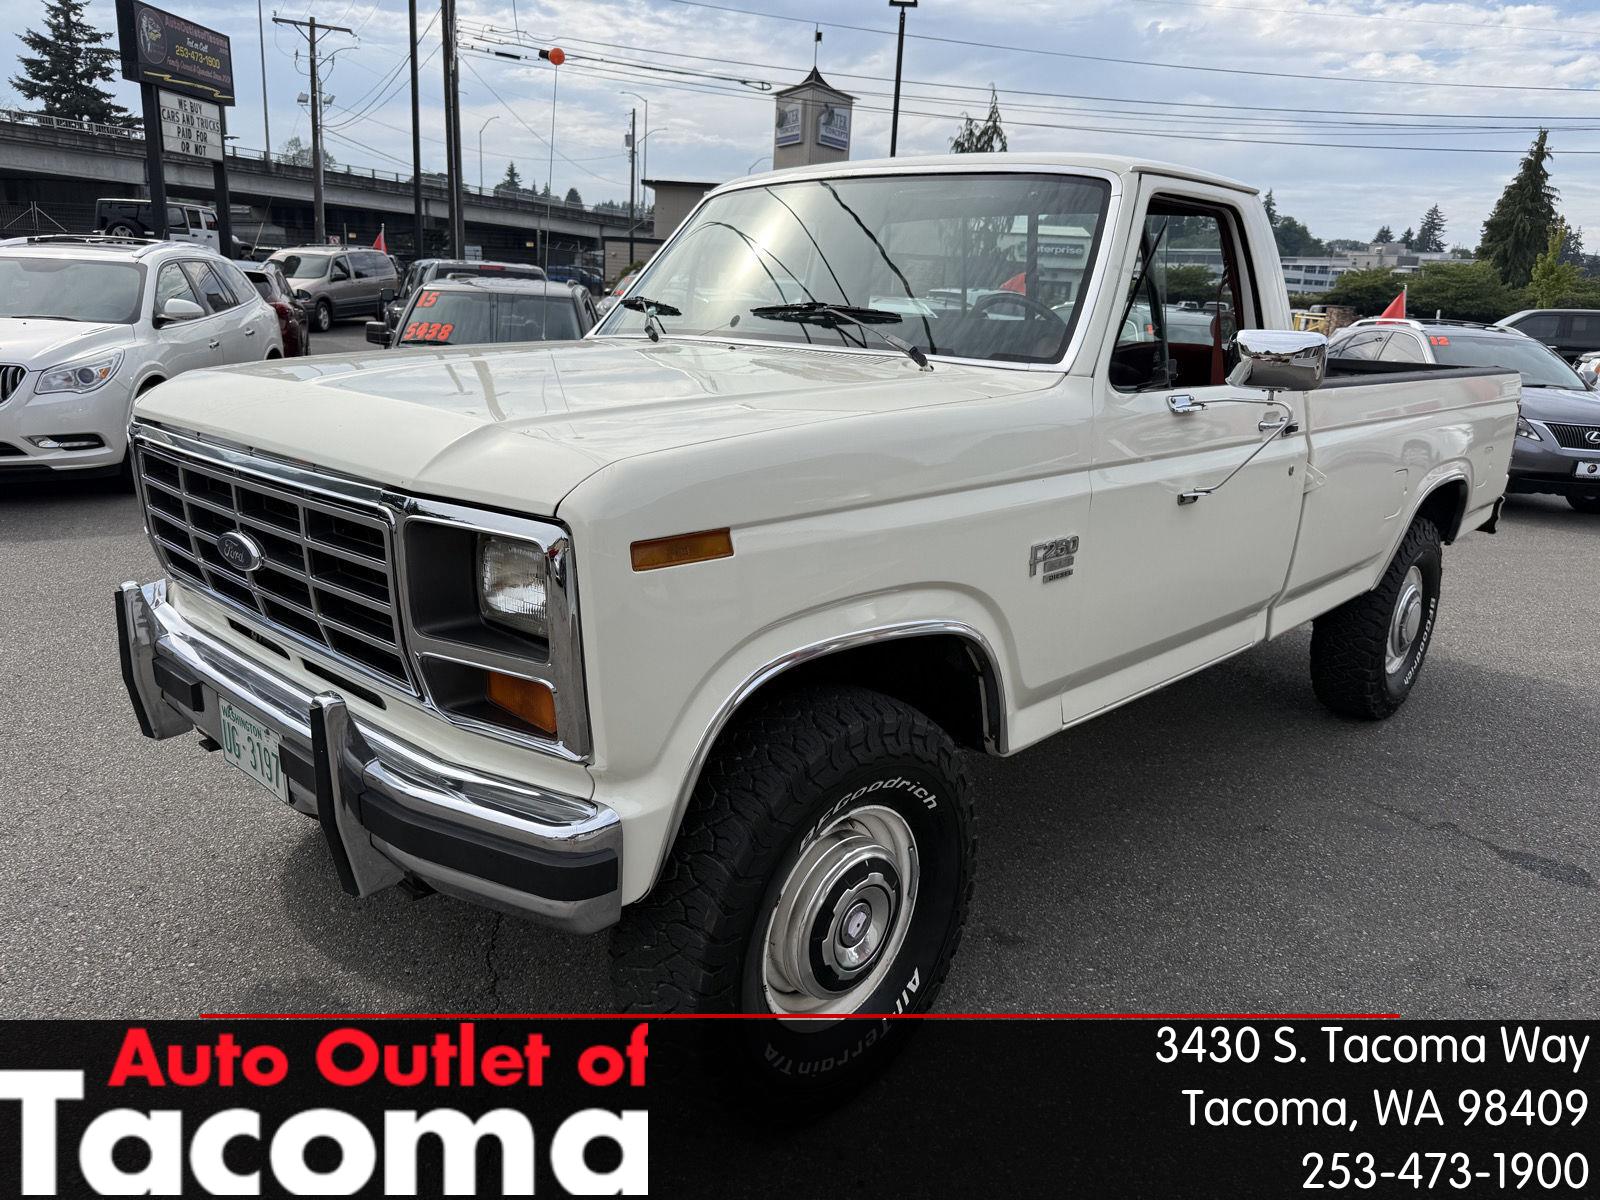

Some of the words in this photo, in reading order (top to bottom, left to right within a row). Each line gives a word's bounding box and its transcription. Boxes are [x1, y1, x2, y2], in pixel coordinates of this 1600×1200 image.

[175, 44, 220, 70] 253-473-1900
[177, 98, 188, 111] WE
[190, 101, 202, 115] BUY
[161, 108, 180, 123] CARS
[182, 113, 194, 126] AND
[196, 116, 220, 133] TRUCKS
[177, 126, 192, 140] PAID
[196, 130, 208, 143] FOR
[181, 141, 190, 153] OR
[195, 144, 206, 156] NOT
[415, 290, 440, 308] 15
[223, 538, 245, 563] Ford
[221, 705, 263, 740] WASHINGTON
